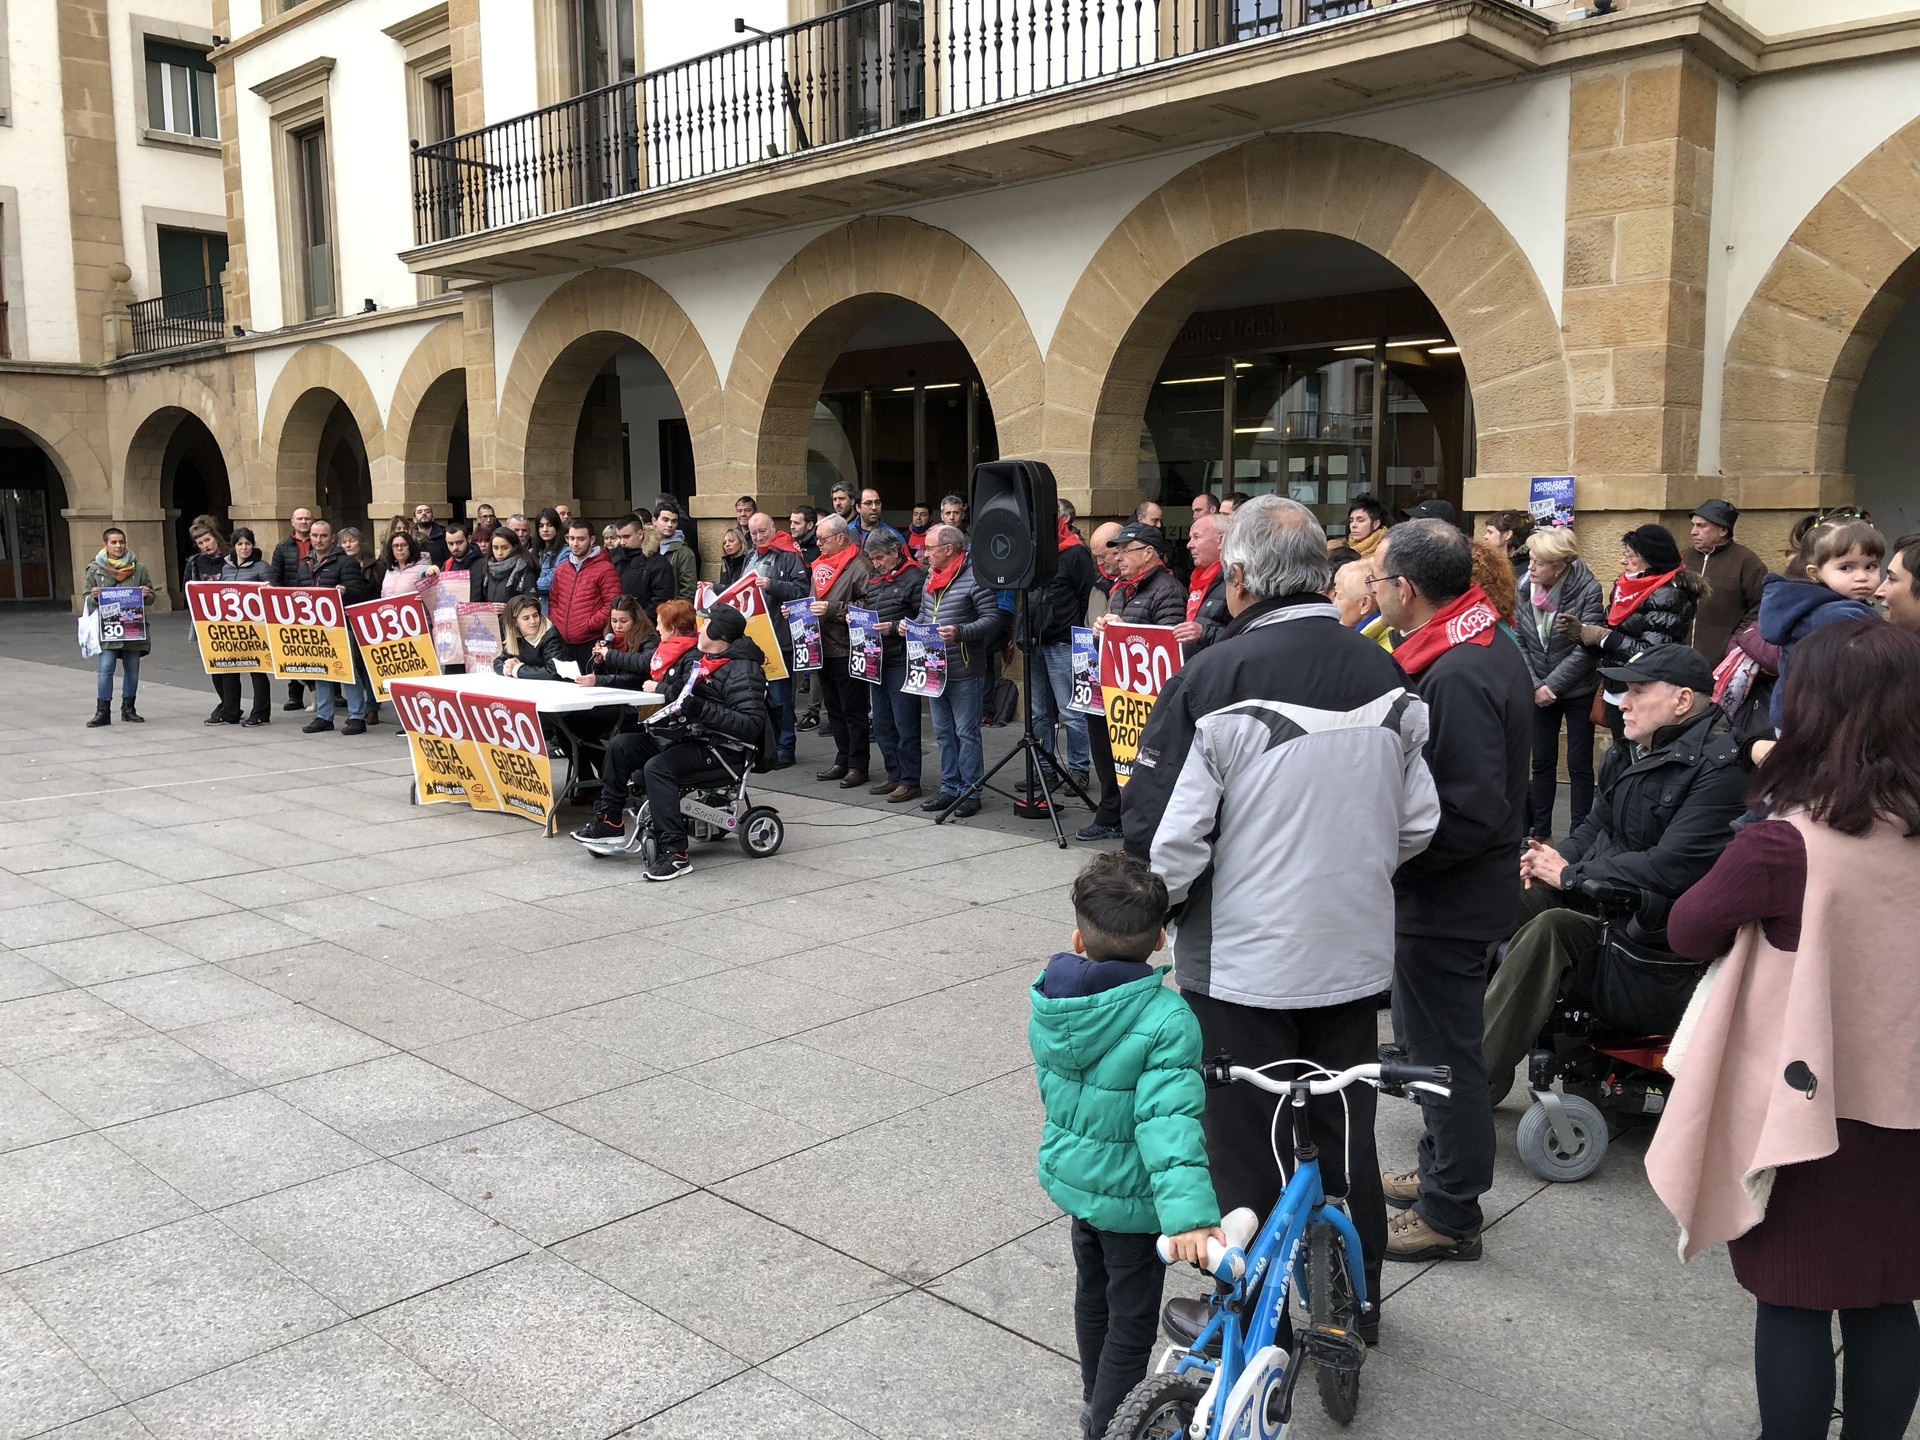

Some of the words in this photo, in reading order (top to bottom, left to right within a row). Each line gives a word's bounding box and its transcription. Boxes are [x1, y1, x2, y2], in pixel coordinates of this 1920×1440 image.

[198, 592, 265, 622] U30
[271, 595, 337, 627] U30
[104, 624, 124, 637] 30
[208, 624, 260, 640] GREBA
[357, 605, 421, 645] U30
[211, 640, 270, 652] OROKORRA
[279, 628, 330, 646] GREBA
[282, 645, 338, 659] OROKORRA
[370, 641, 419, 665] GREBA
[796, 648, 809, 663] 30
[376, 657, 428, 677] OROKORRA
[851, 656, 866, 673] 30
[908, 670, 927, 688] 30
[1074, 685, 1092, 705] 30
[400, 695, 463, 740] U30
[471, 705, 540, 755] U30
[491, 749, 540, 780] GREBA
[499, 771, 550, 797] OROKORRA
[692, 807, 724, 825] Sorolla
